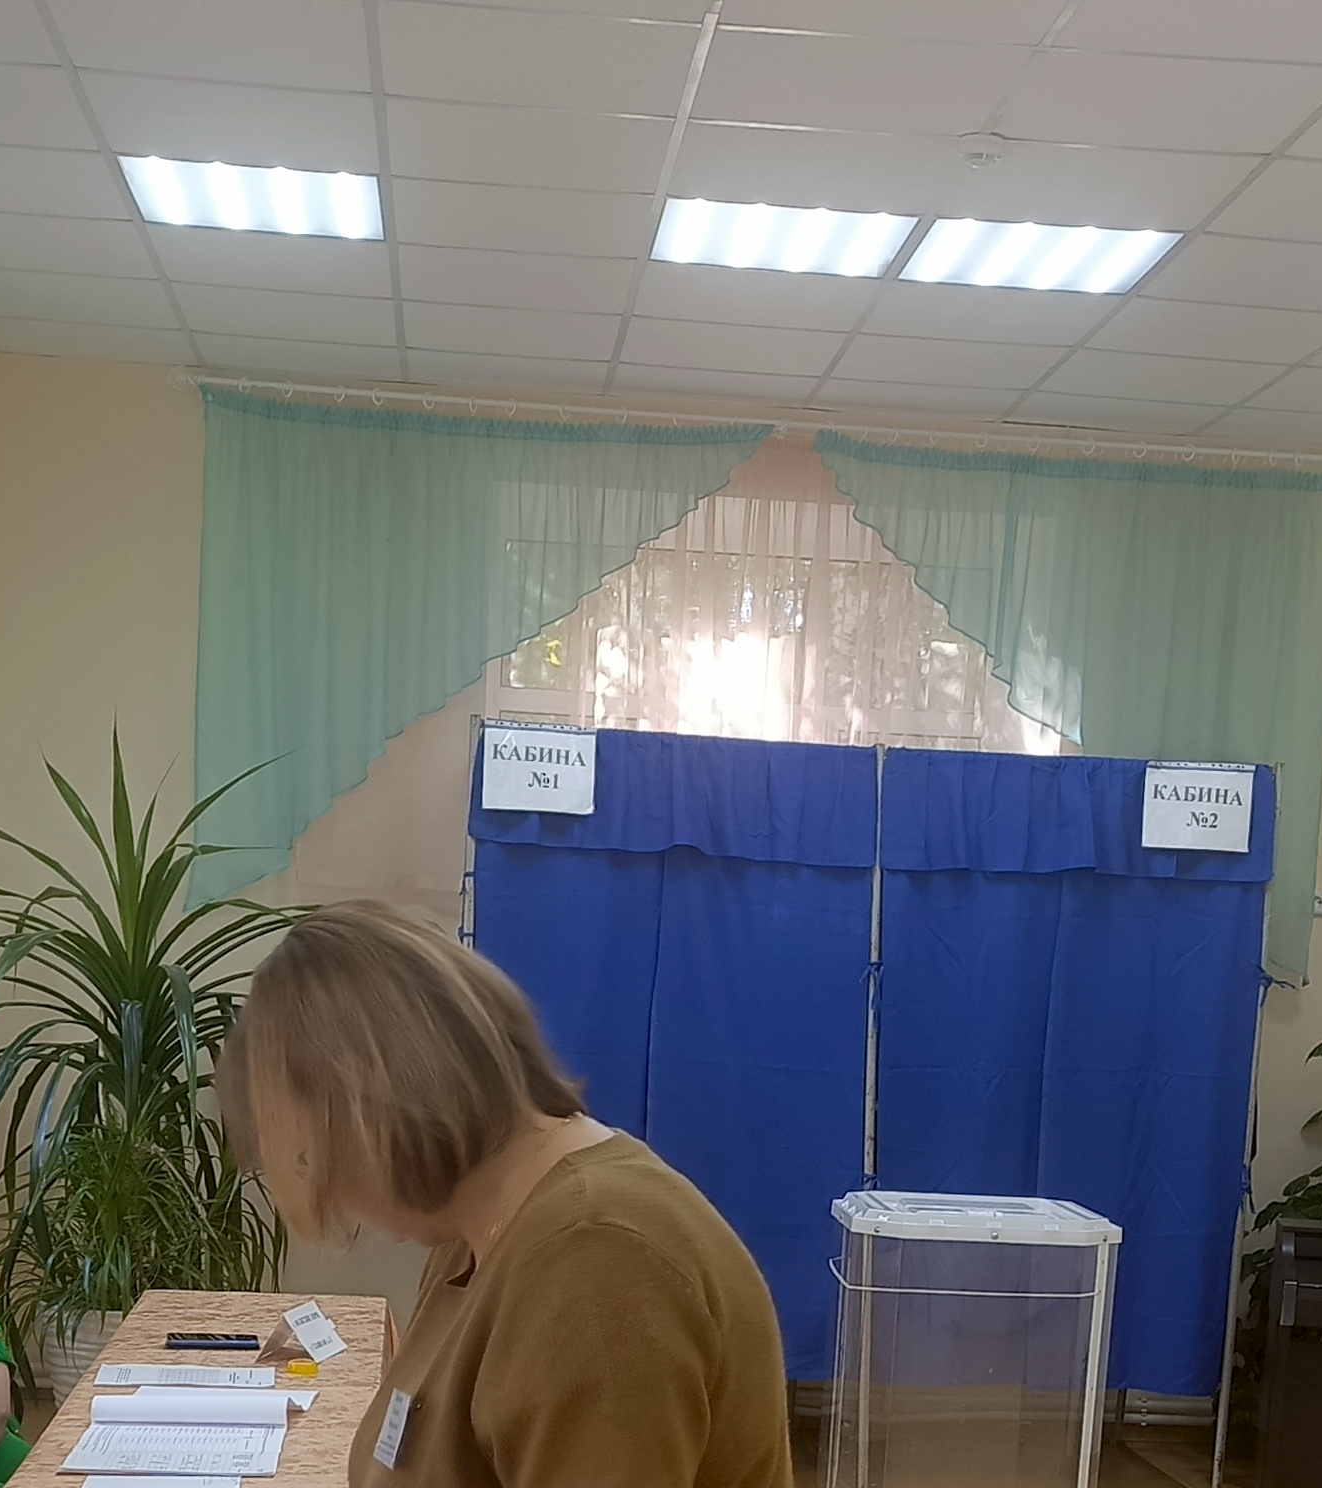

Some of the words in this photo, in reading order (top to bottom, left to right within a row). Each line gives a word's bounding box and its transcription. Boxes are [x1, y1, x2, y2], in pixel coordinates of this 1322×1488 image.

[491, 743, 587, 768] КАБИНА
[527, 771, 559, 789] №1
[1152, 783, 1243, 807] КАБИНА
[1186, 811, 1219, 829] №2
